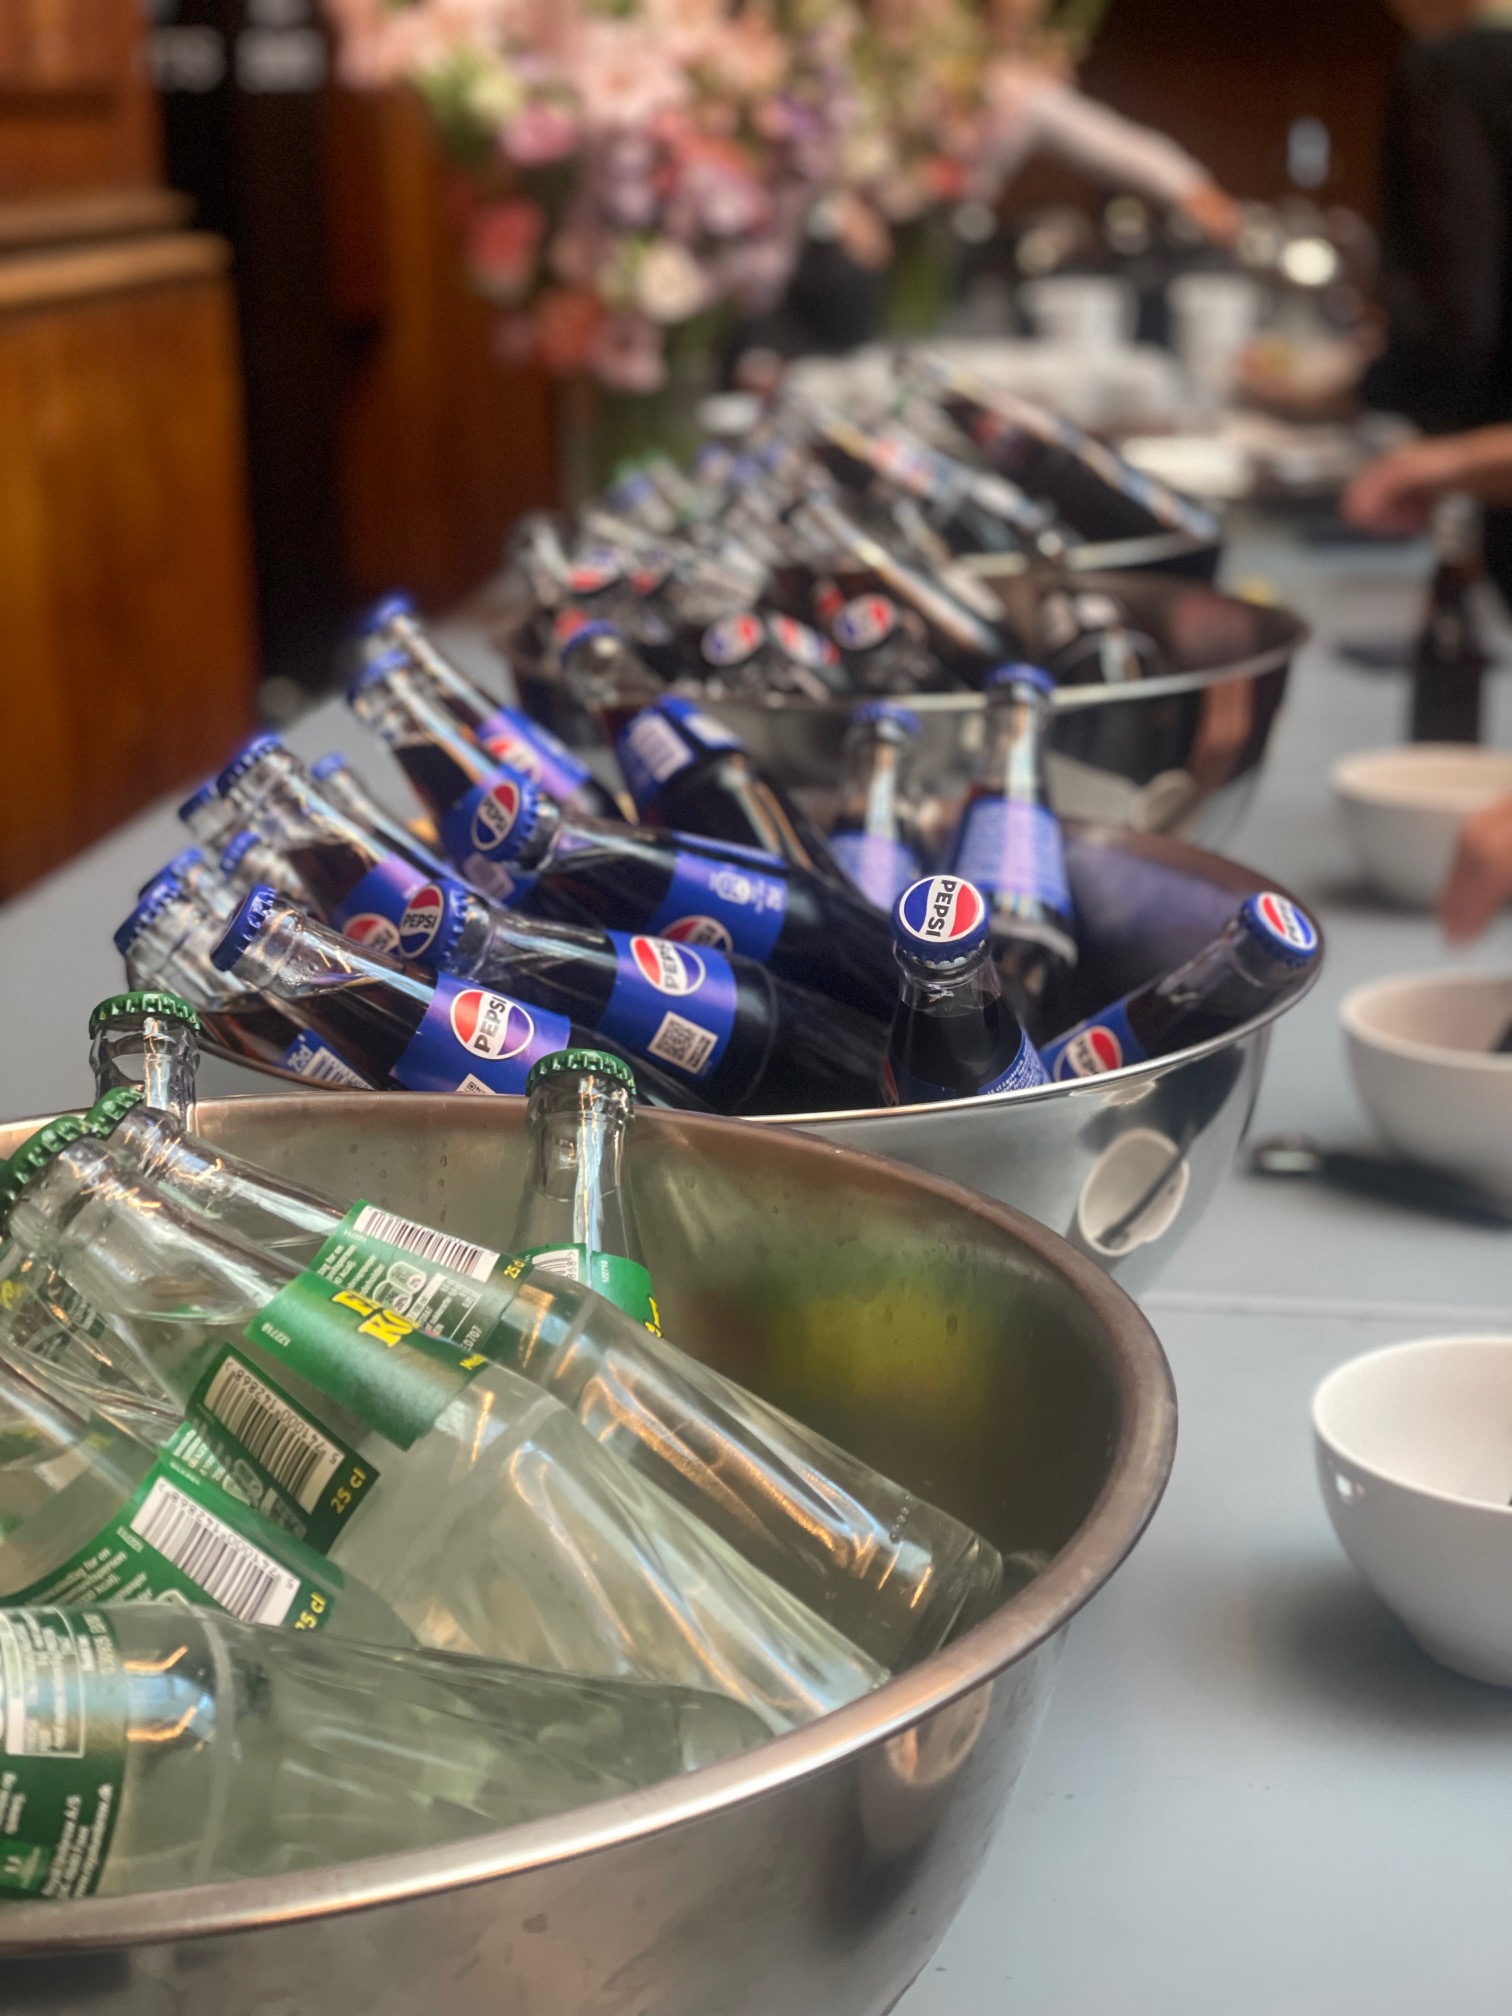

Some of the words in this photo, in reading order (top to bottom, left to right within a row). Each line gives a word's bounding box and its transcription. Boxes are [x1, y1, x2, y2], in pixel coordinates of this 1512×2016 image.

[402, 913, 439, 929] PEPSI
[925, 880, 958, 938] PEPSI
[473, 996, 508, 1054] PEPSI
[234, 1369, 277, 1410] 142868
[279, 1409, 325, 1453] 741000
[331, 1486, 352, 1514] 25
[350, 1466, 367, 1488] cl
